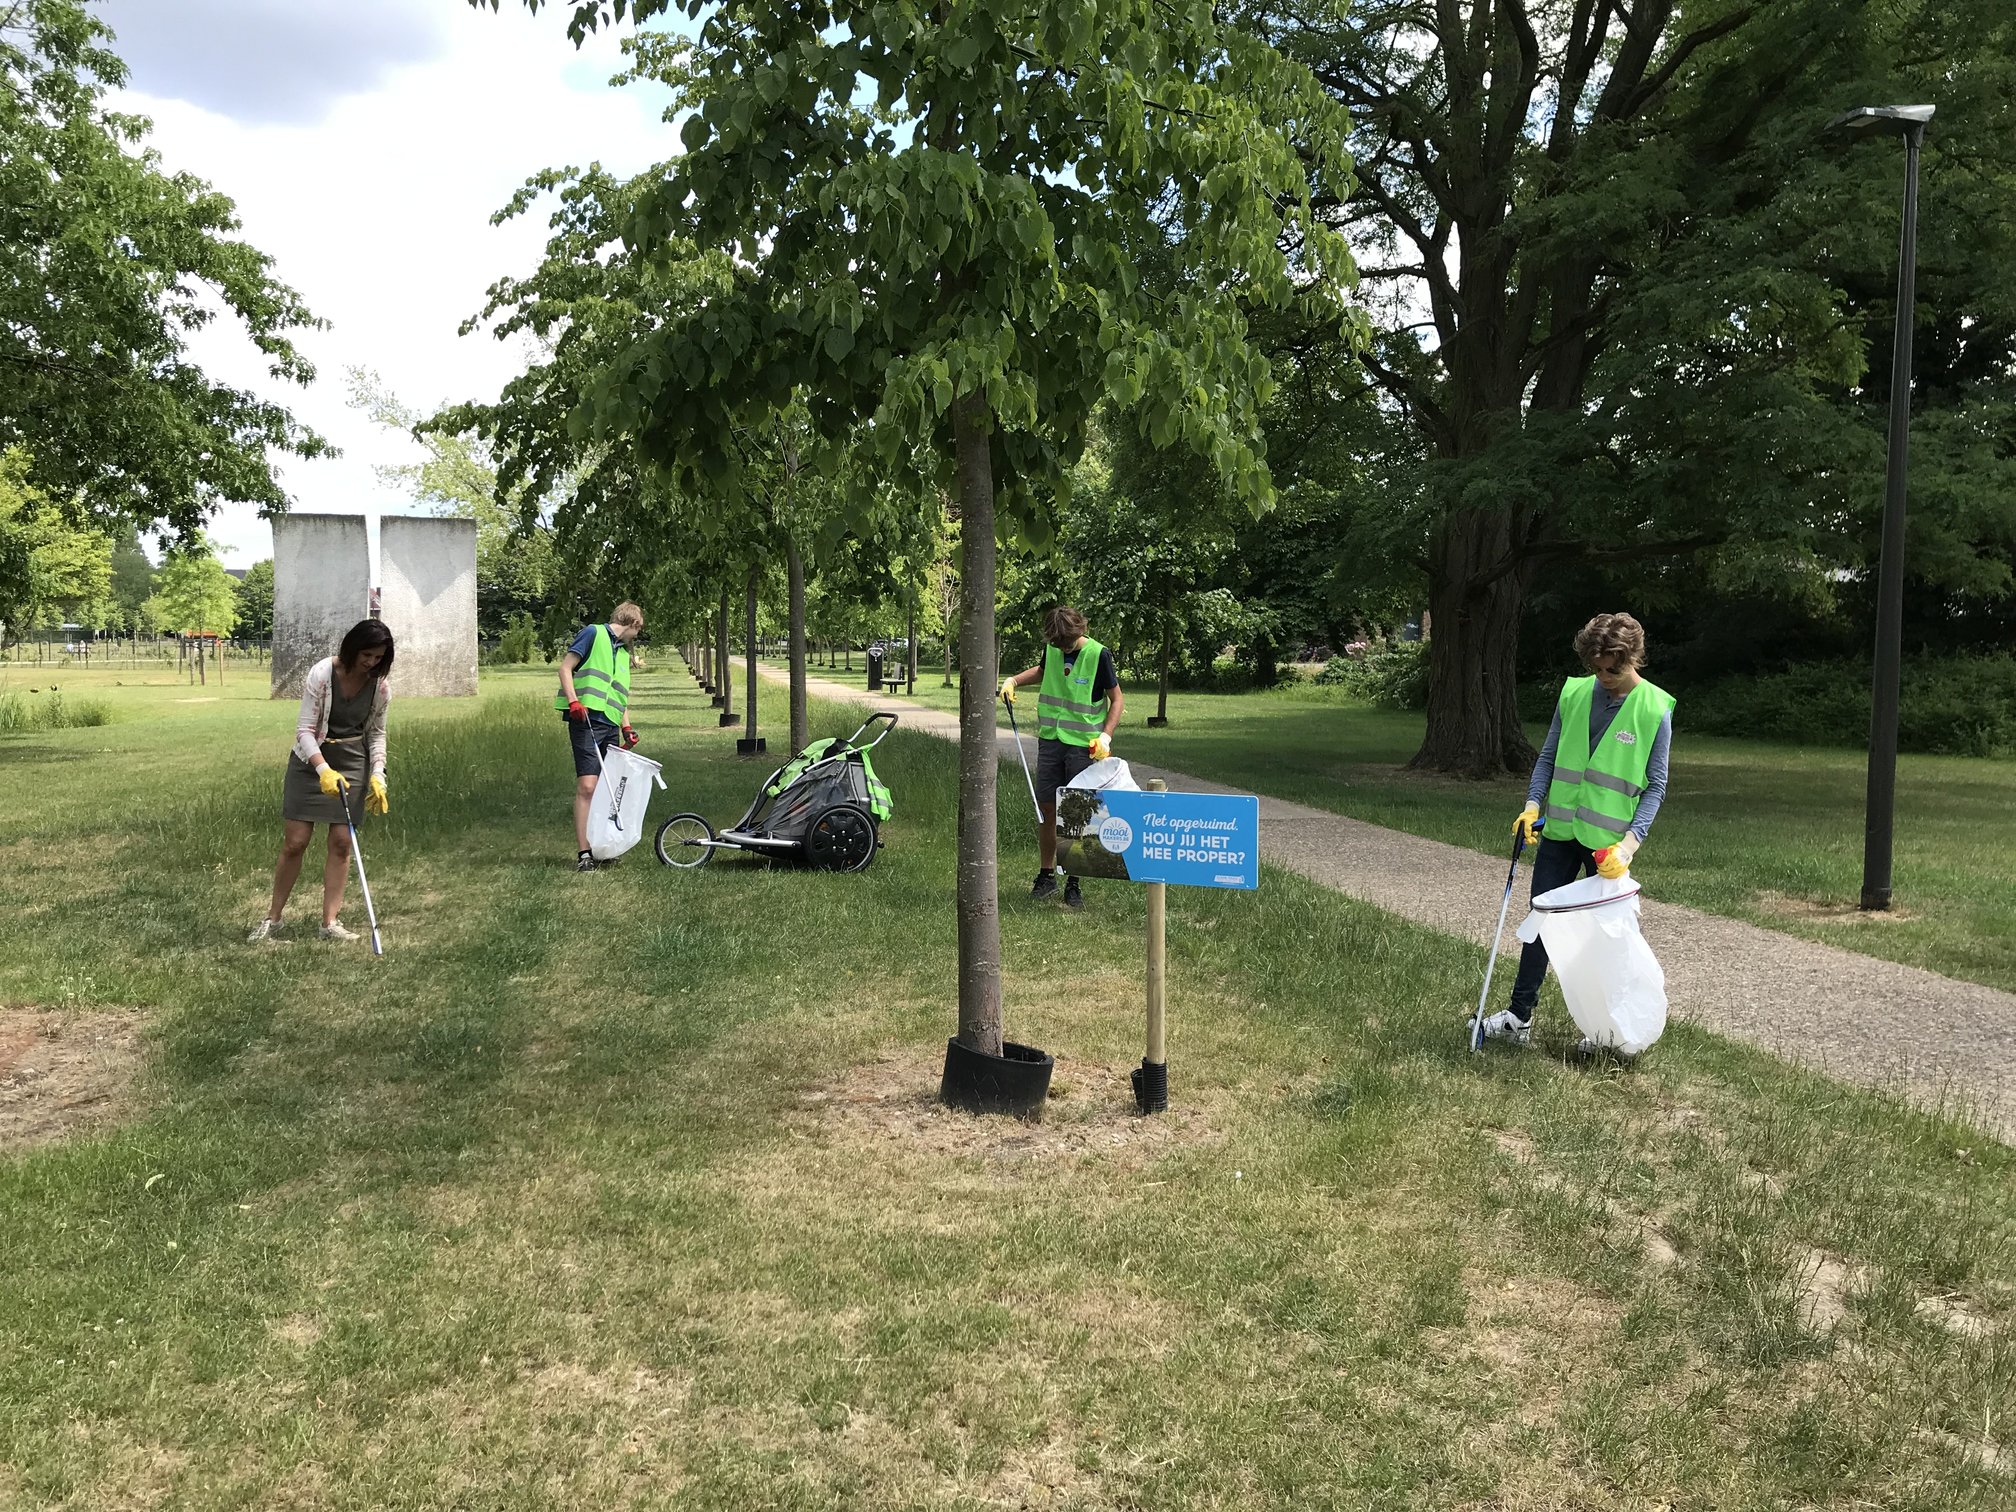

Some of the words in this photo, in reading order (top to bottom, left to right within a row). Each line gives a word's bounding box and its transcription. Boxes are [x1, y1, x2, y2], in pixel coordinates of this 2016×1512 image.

[1143, 813, 1167, 827] Net
[1169, 818, 1238, 832] opgeruimd.
[1103, 828, 1128, 837] mooi
[1143, 832, 1175, 845] HOU
[1180, 834, 1195, 846] JIJ
[1201, 835, 1230, 848] HET
[1143, 847, 1172, 860] MEE
[1177, 849, 1246, 865] PROPER?
